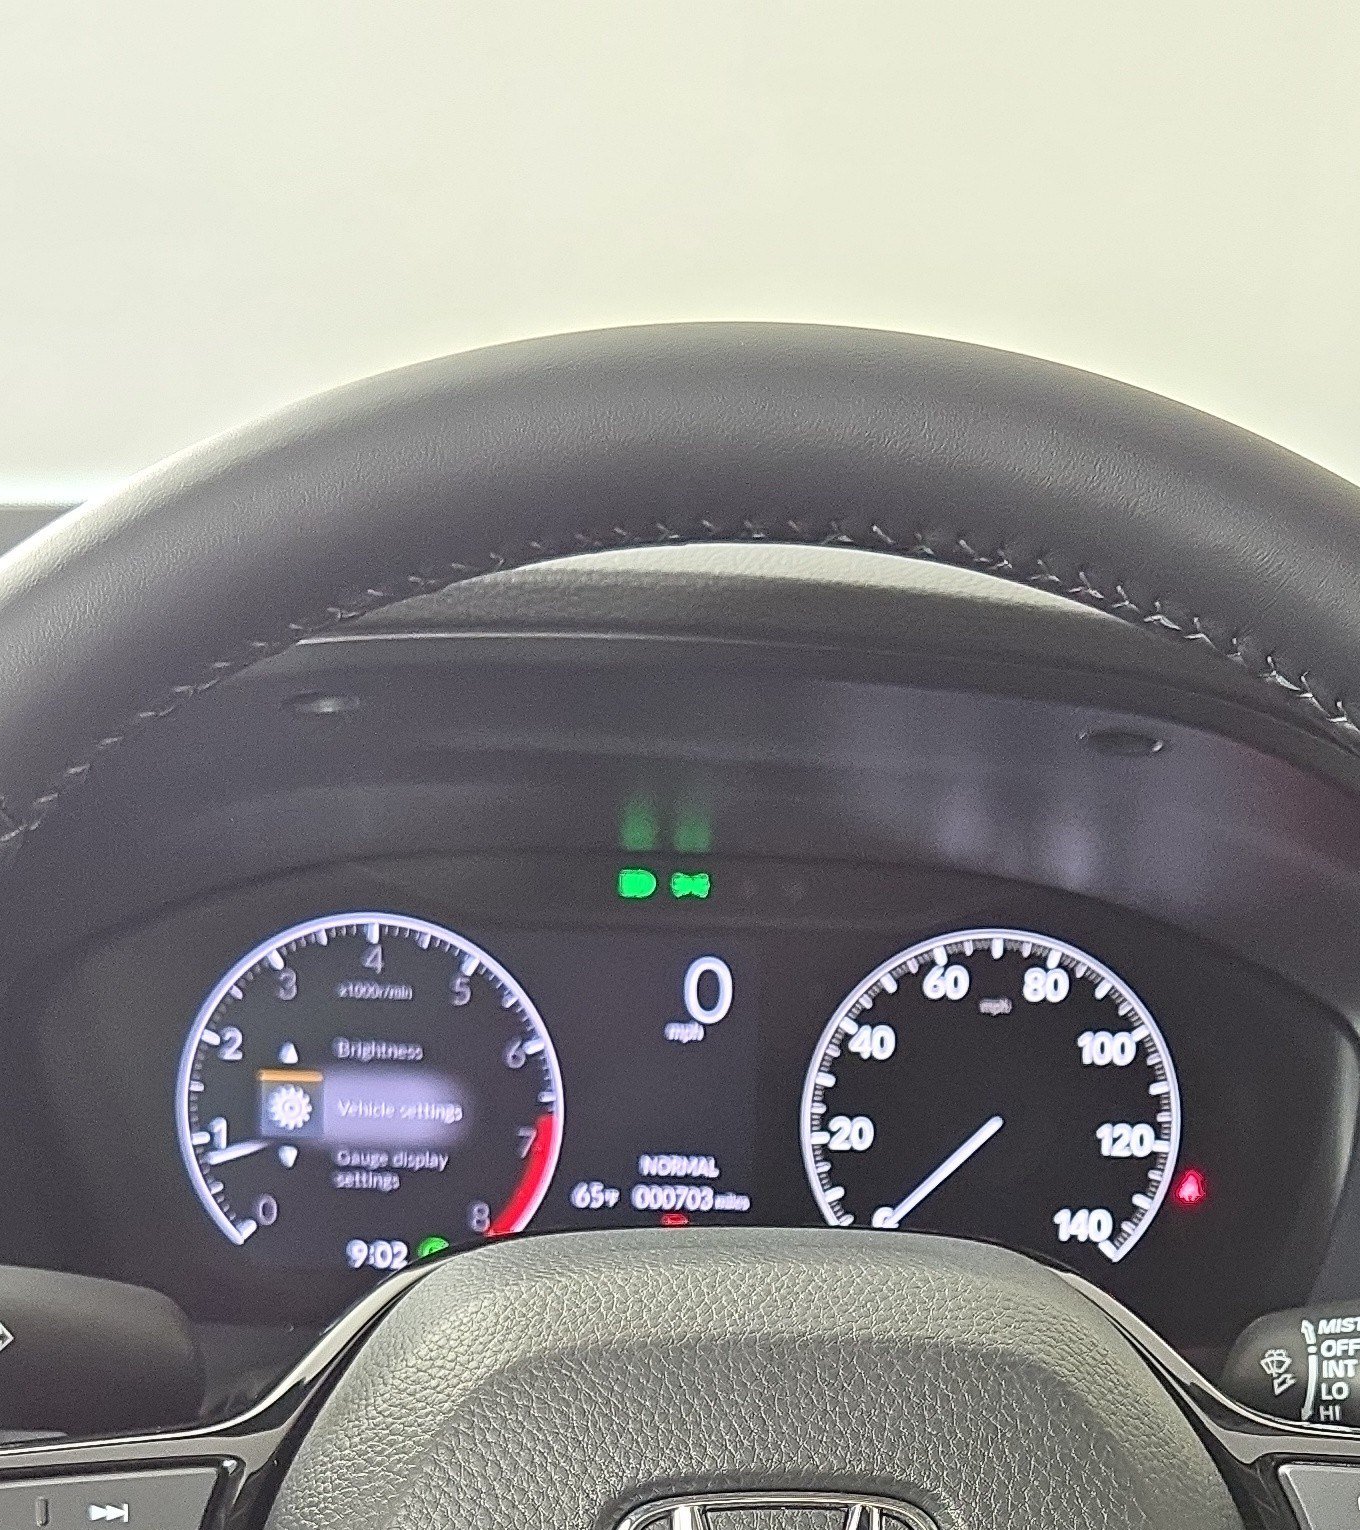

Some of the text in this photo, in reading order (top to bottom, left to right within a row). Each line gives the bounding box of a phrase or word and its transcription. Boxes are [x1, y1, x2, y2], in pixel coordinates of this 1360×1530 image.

[362, 944, 385, 975] 4
[277, 968, 298, 1001] 3
[451, 976, 472, 1006] 5
[683, 956, 733, 1024] 0
[923, 964, 970, 1000] 60
[1023, 967, 1070, 1003] 80
[219, 1028, 244, 1062] 2
[665, 1021, 705, 1043] mph
[848, 1024, 896, 1061] 40
[336, 1039, 424, 1061] Brightness
[504, 1038, 526, 1069] 6
[1077, 1031, 1137, 1066] 100
[339, 1100, 463, 1124] Vehicle settings
[209, 1115, 229, 1149] 1
[516, 1127, 538, 1158] 7
[827, 1115, 874, 1152] 20
[1096, 1122, 1155, 1158] 120
[337, 1150, 449, 1172] Gauge display
[639, 1154, 720, 1178] NORMAL
[333, 1171, 401, 1191] settings
[255, 1192, 279, 1227] 0
[631, 1184, 714, 1211] 000703
[469, 1201, 491, 1232] 8
[1054, 1208, 1114, 1243] 140
[346, 1240, 409, 1268] 9:02
[1322, 1359, 1359, 1379] INT
[1321, 1381, 1349, 1401] LO
[1319, 1405, 1341, 1421] HI
